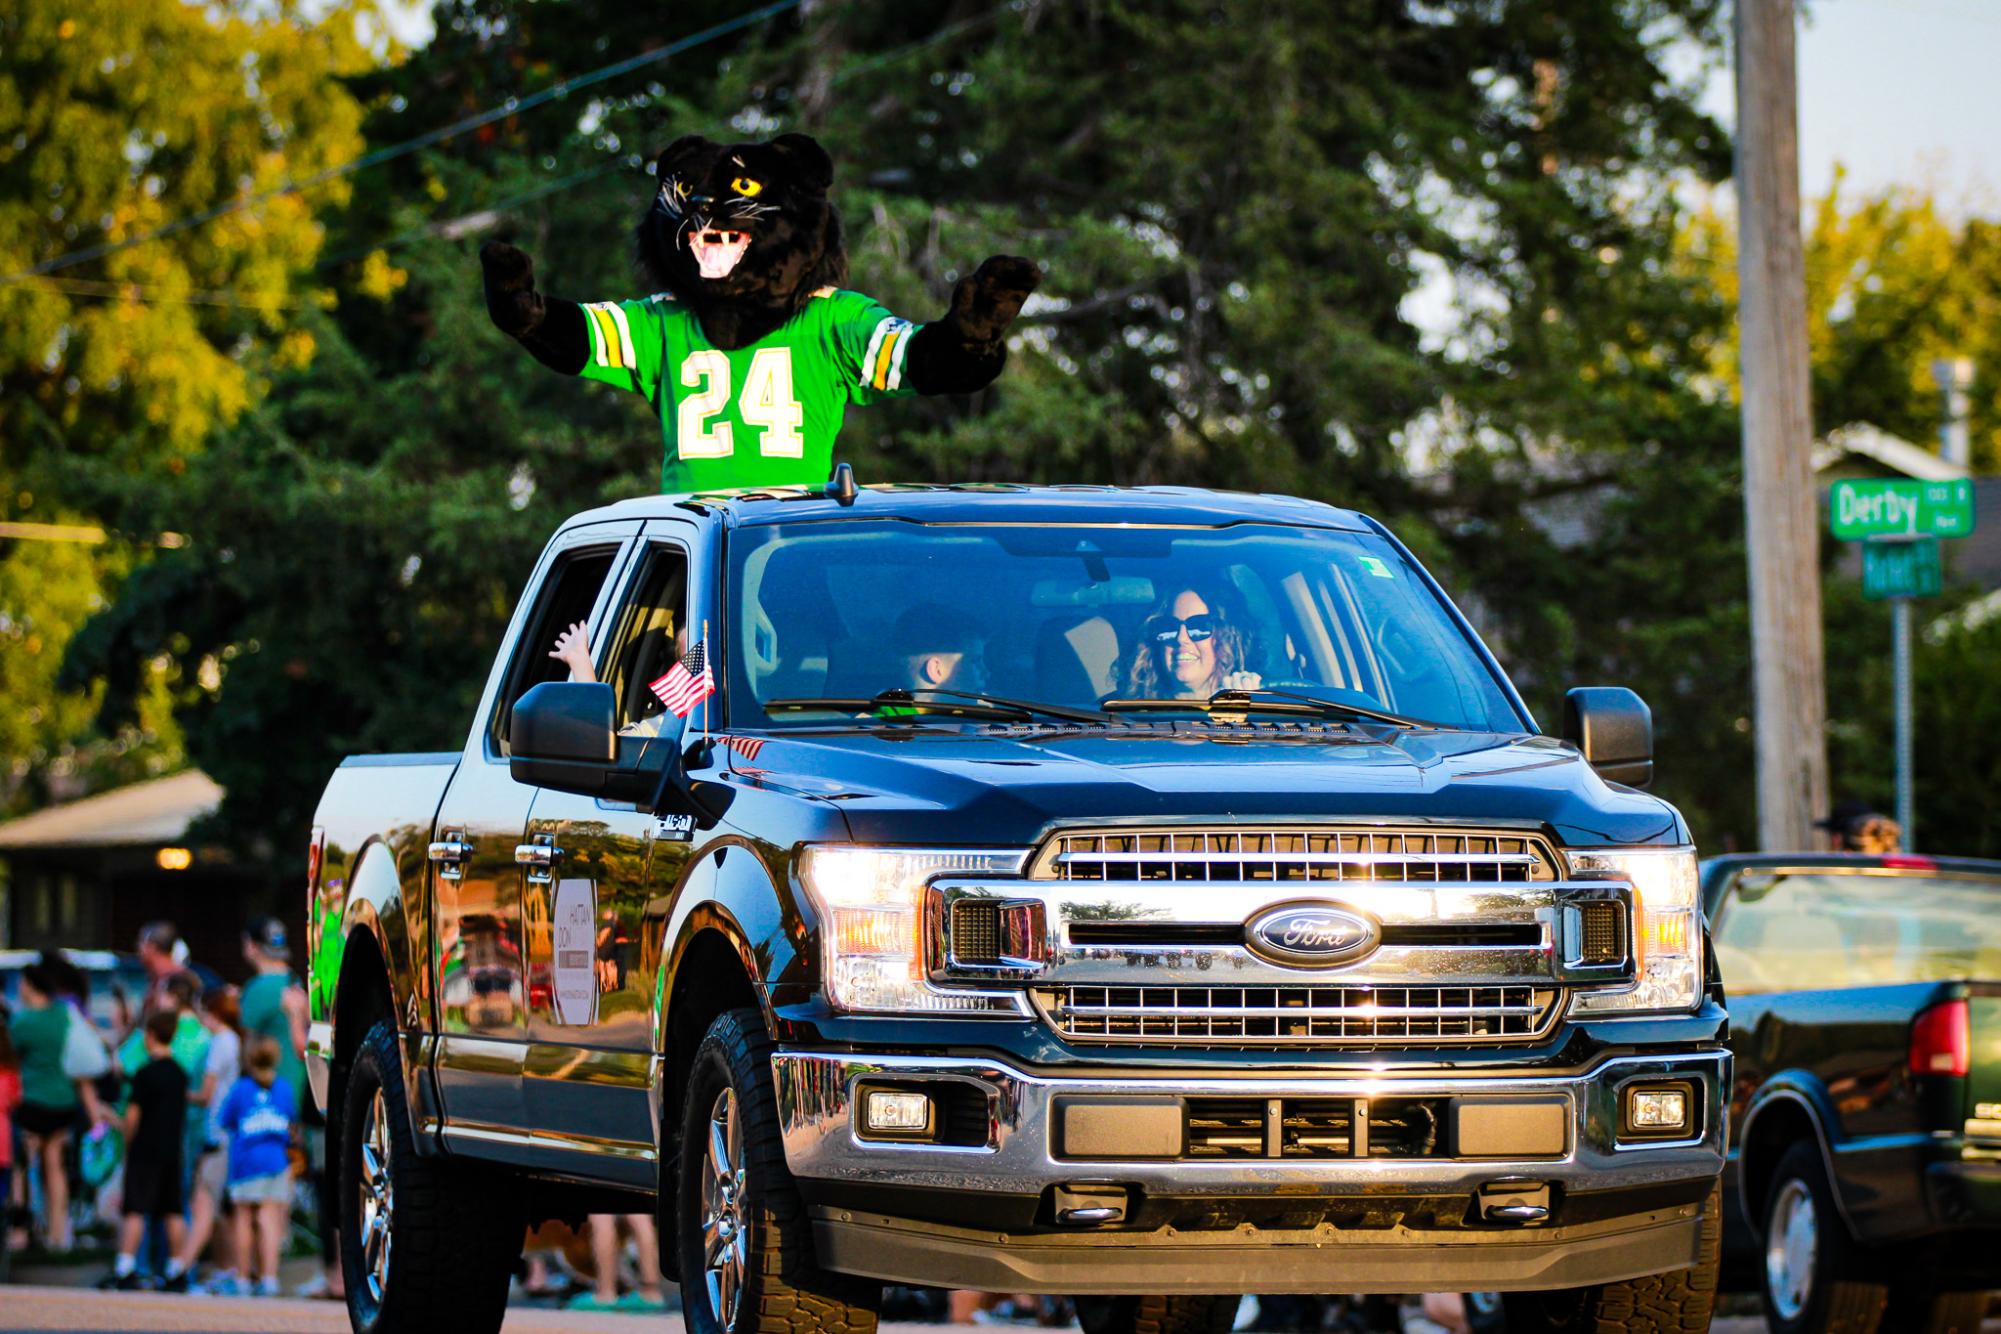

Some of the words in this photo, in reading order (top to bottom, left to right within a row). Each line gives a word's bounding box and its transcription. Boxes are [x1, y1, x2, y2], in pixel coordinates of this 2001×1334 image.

[677, 347, 804, 460] 24
[1838, 483, 1918, 535] Derby
[1283, 918, 1347, 946] Ford
